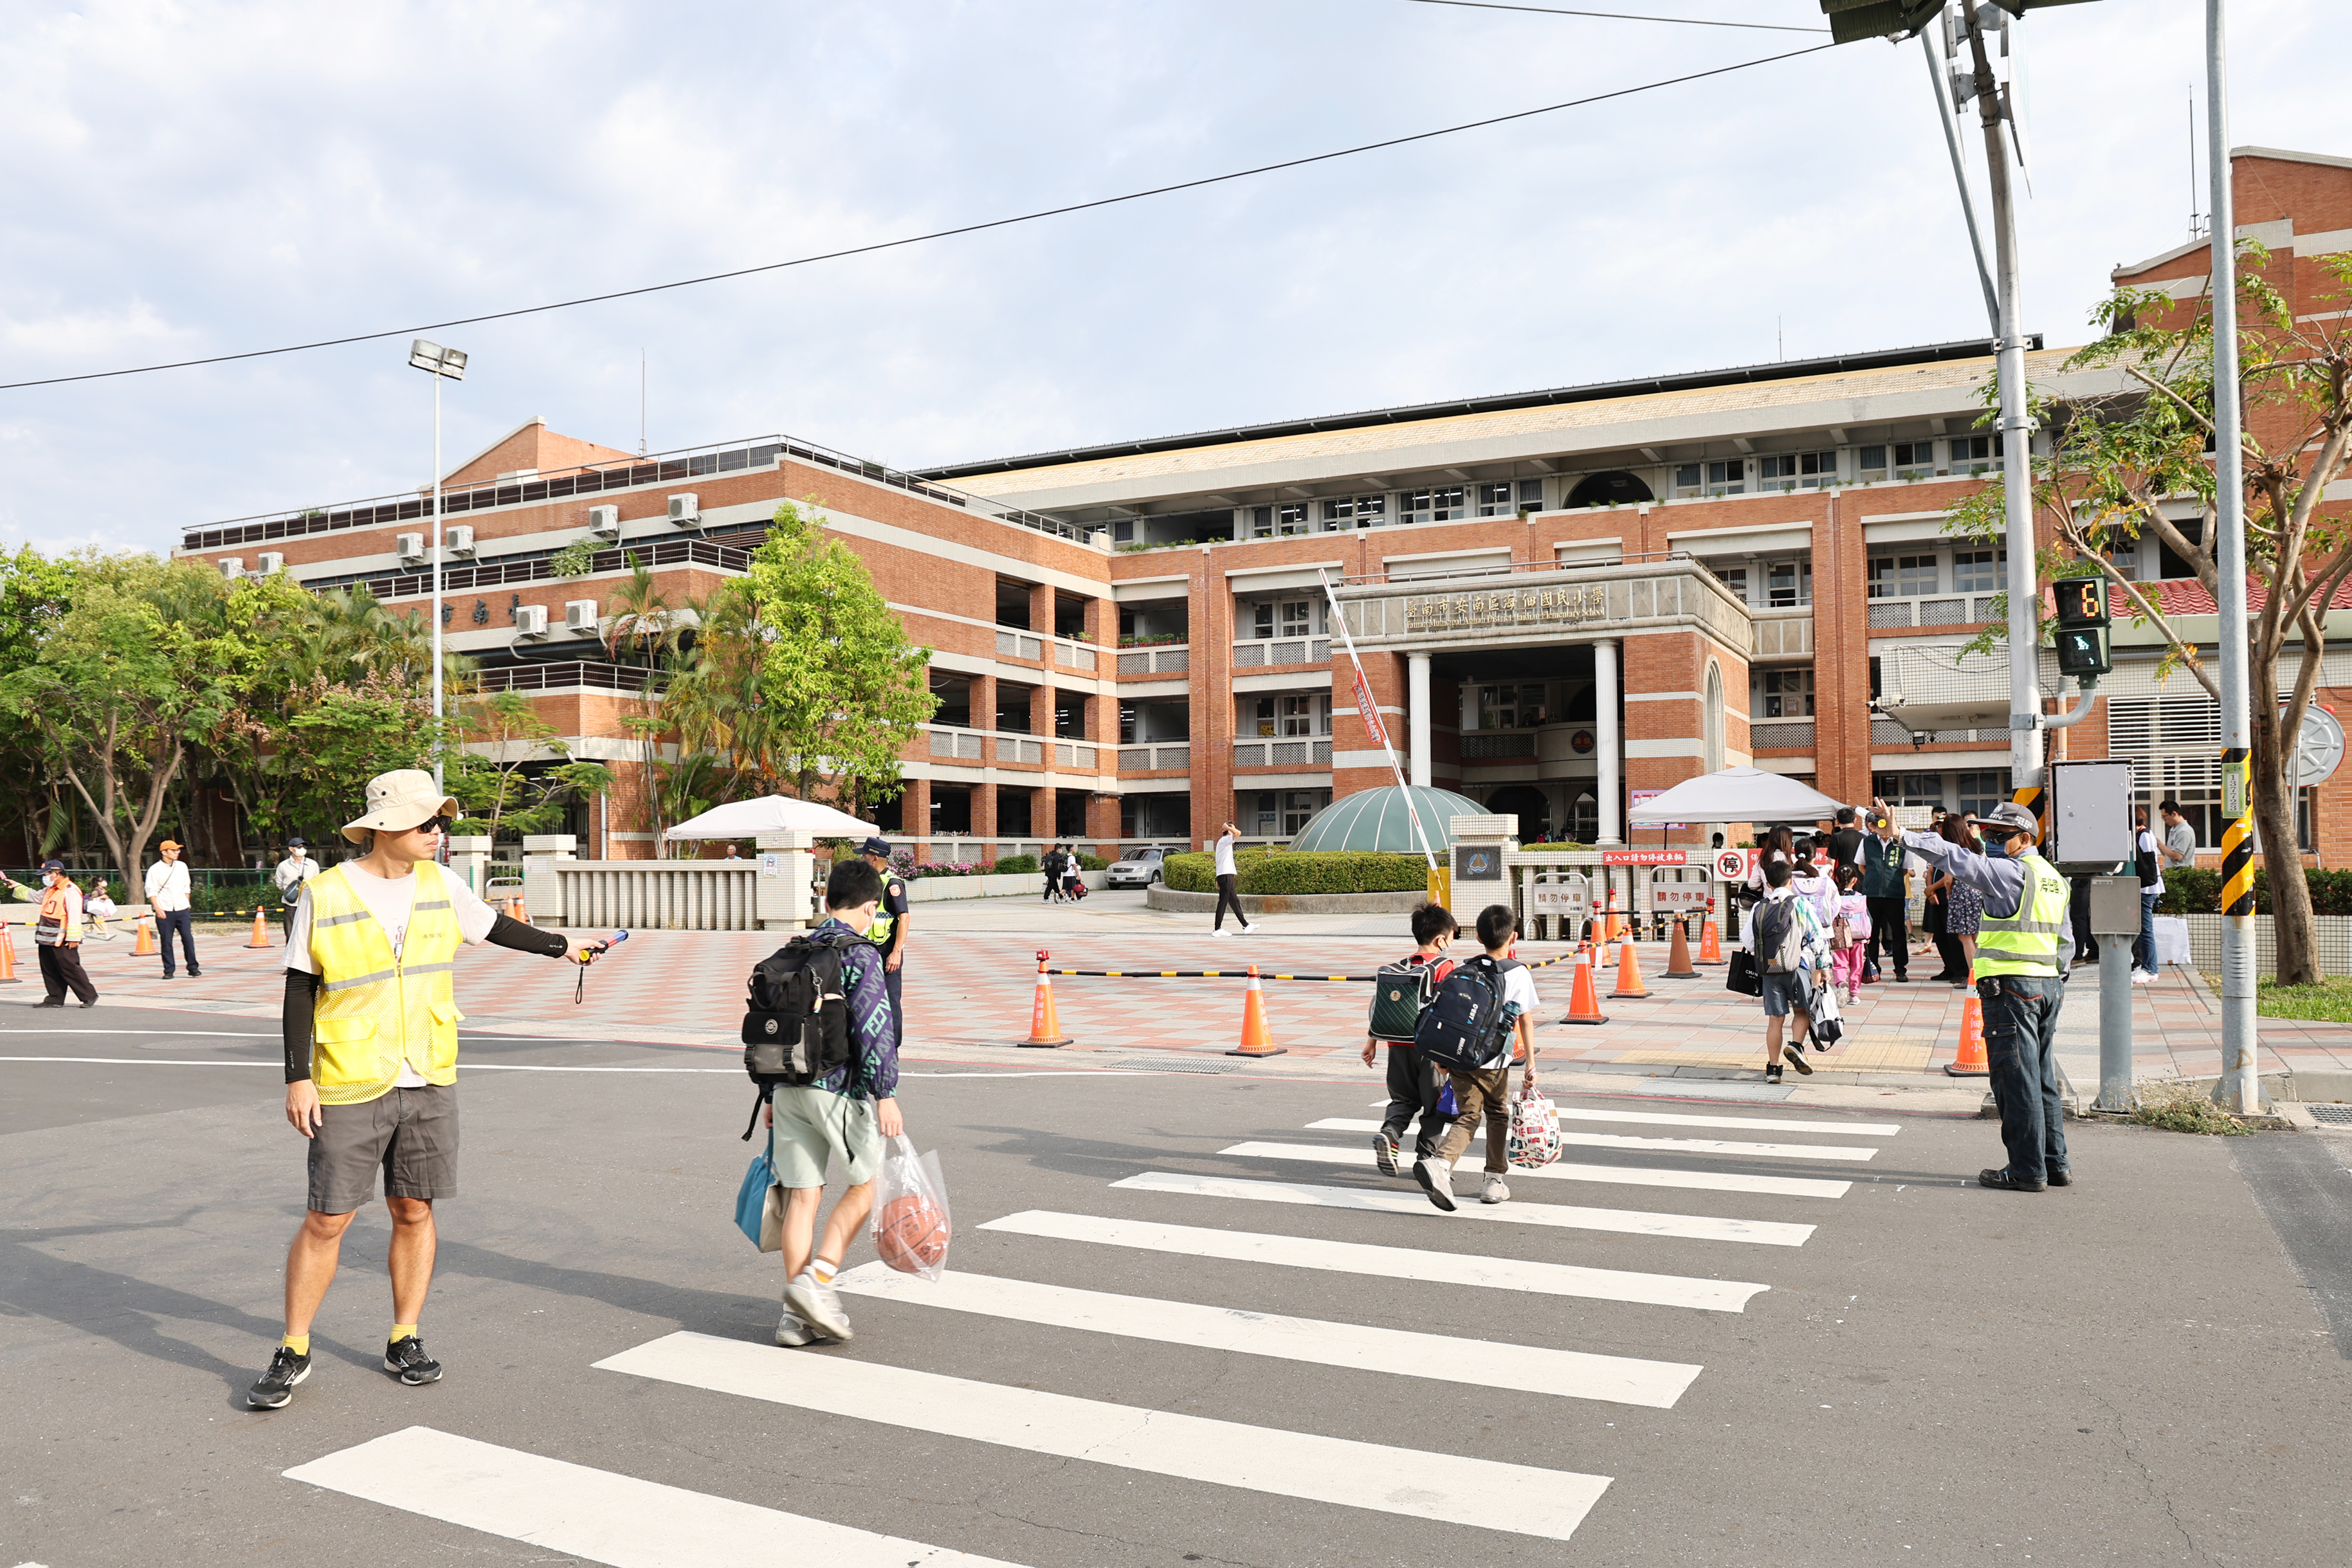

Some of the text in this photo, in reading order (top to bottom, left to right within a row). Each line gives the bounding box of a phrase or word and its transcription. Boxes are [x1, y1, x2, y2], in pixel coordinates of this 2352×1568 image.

[1405, 587, 1604, 617] 臺南市安南區海佃國民小學
[2081, 583, 2099, 617] 6
[1406, 620, 1427, 628] Tainan
[1429, 617, 1461, 628] Municipal
[1487, 614, 1512, 623] District
[1514, 612, 1539, 621] Haidian
[1542, 610, 1580, 619] Elementary
[1582, 606, 1605, 617] School
[1605, 851, 1684, 862] 出入口請勿停放車輛
[1723, 857, 1738, 873] 停
[1538, 893, 1581, 903] 請勿停車
[1657, 891, 1705, 902] 請勿停車
[1035, 990, 1044, 1028] 海佃國小
[1969, 1005, 1982, 1053] 海佃國小
